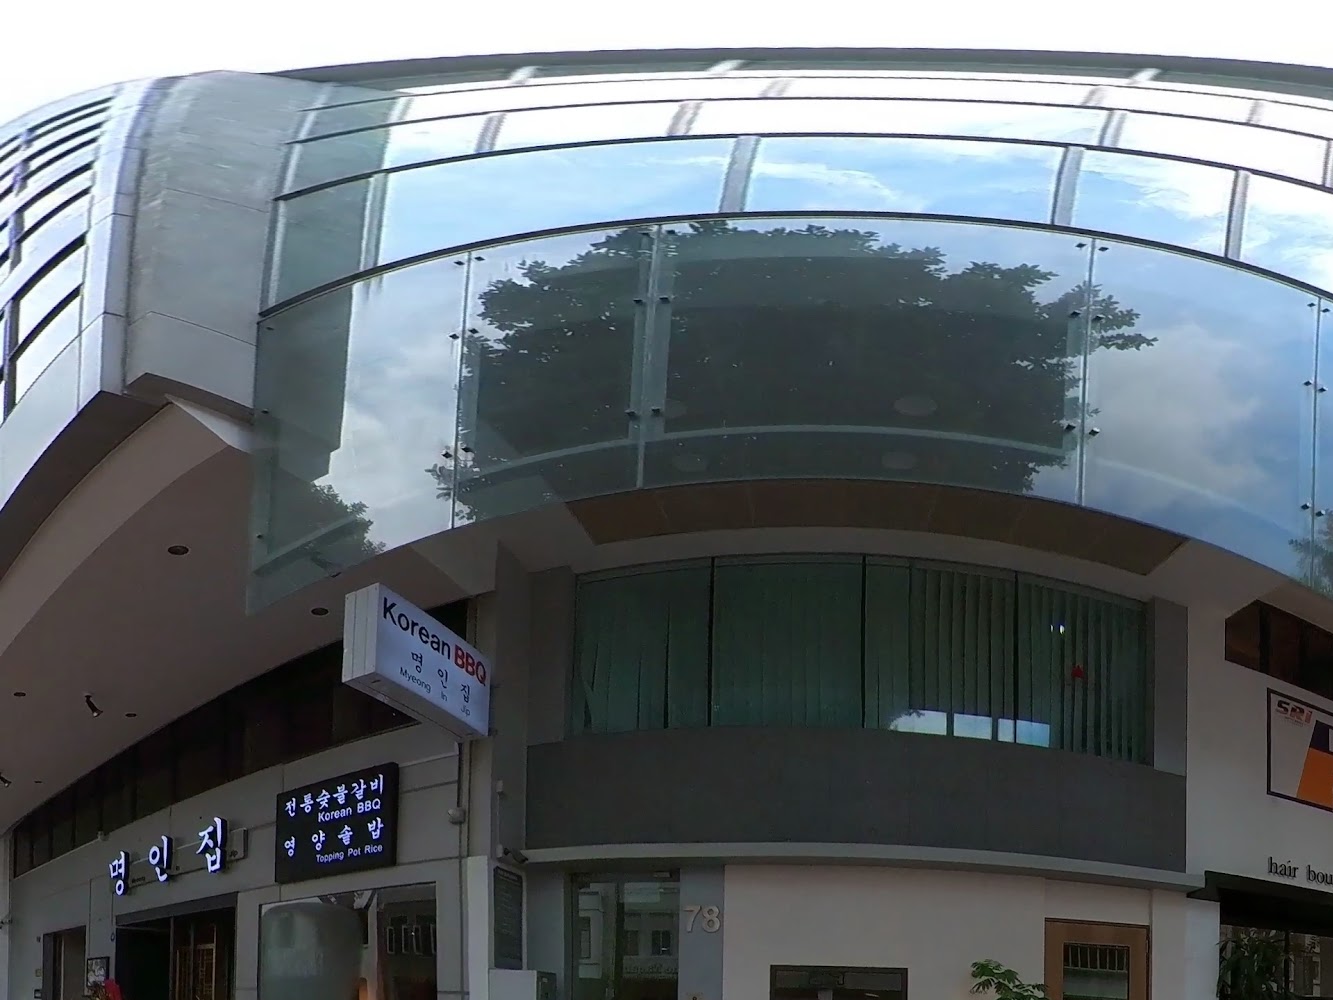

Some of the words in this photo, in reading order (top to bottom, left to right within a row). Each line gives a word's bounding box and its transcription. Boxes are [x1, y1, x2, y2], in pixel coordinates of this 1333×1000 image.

[383, 597, 451, 660] Korean
[454, 644, 487, 687] BBQ
[400, 666, 432, 694] Myeong
[317, 806, 353, 823] Korean
[356, 797, 382, 814] BBQ
[315, 850, 345, 863] Topping
[347, 846, 361, 857] Pot
[364, 843, 383, 854] Rice
[1268, 856, 1299, 878] hair
[682, 905, 721, 934] 78
